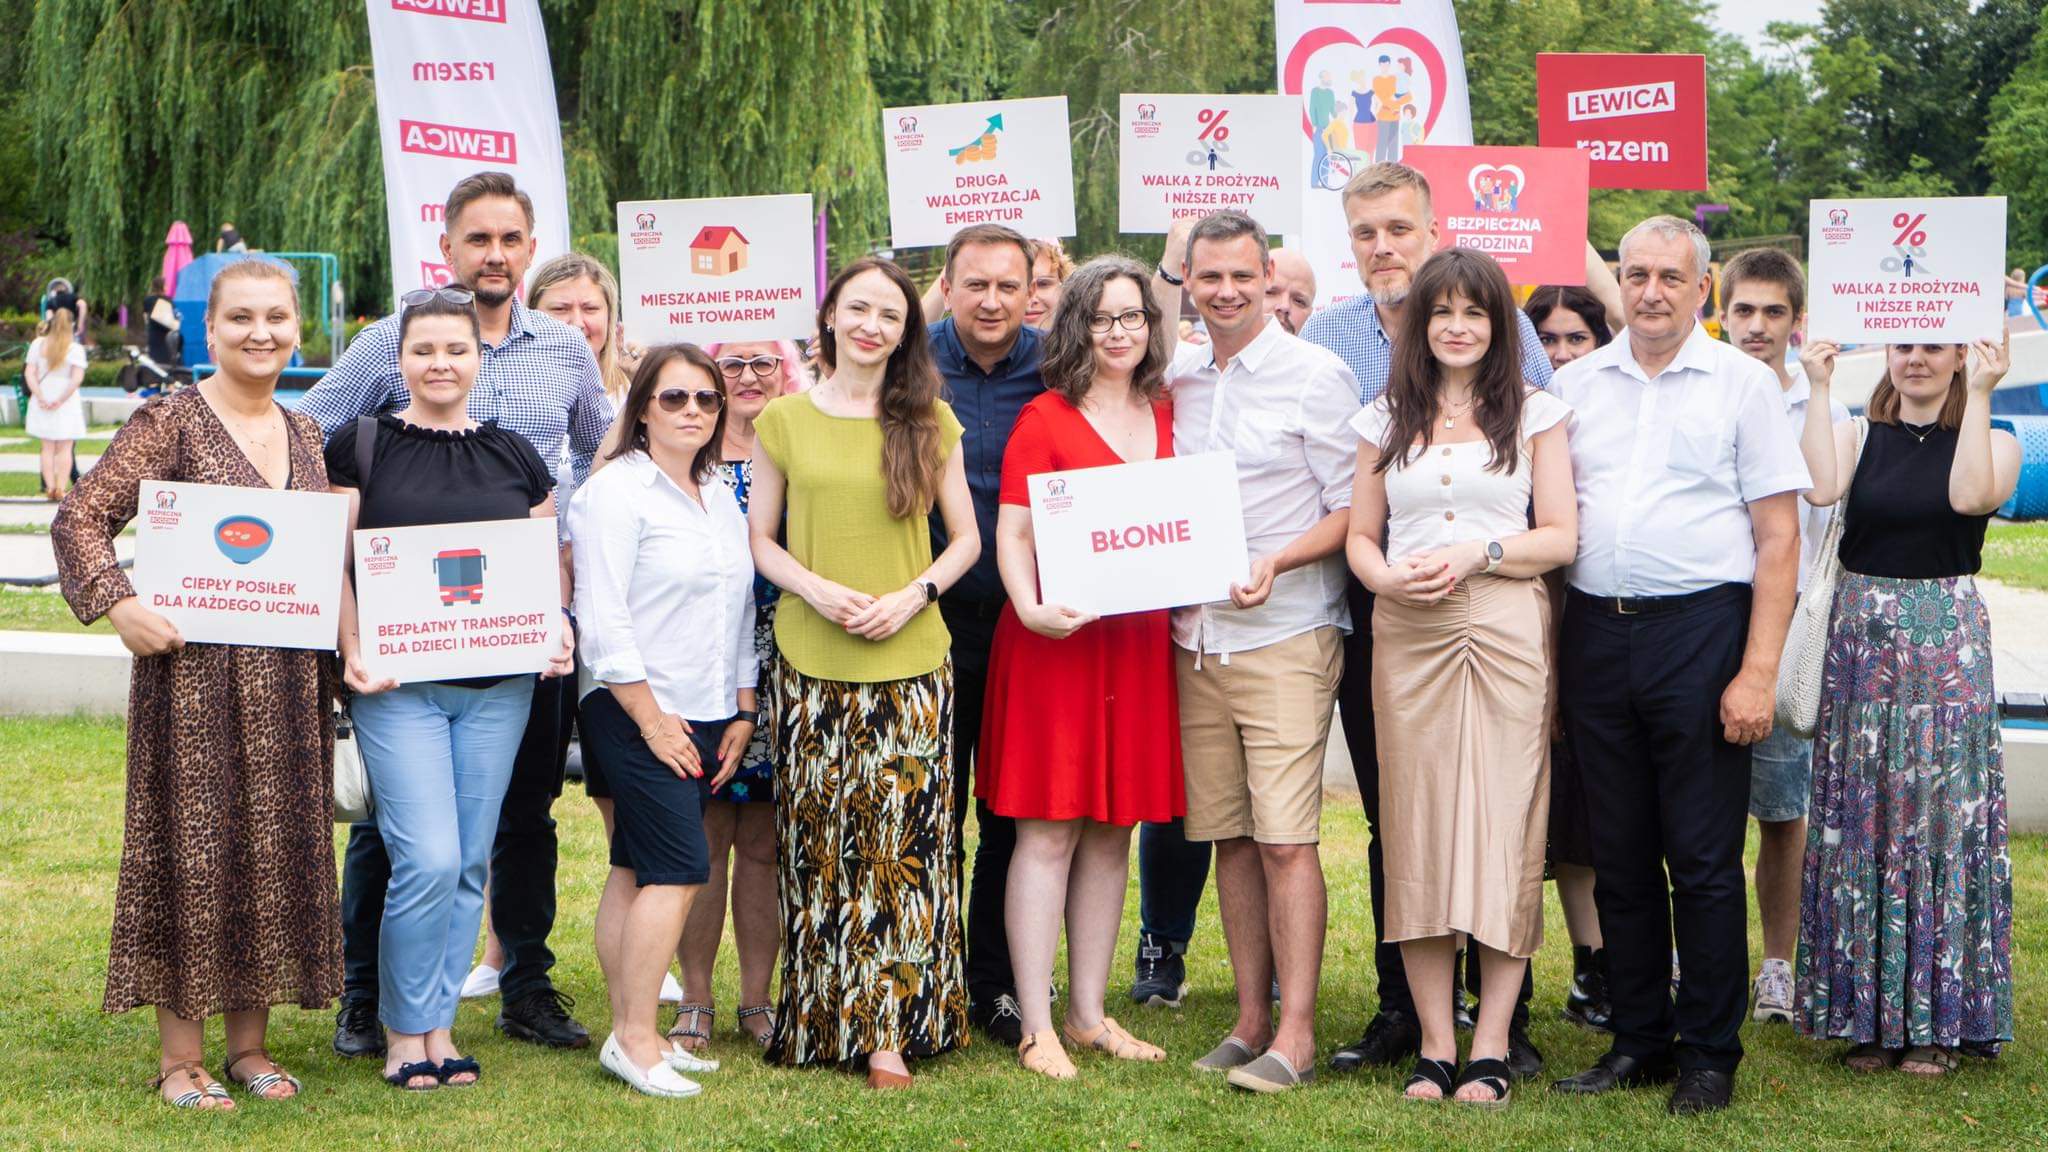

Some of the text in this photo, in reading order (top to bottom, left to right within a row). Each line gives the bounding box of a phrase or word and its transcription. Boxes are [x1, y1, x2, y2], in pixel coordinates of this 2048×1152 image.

[1574, 87, 1670, 115] LEWICA
[955, 174, 1008, 188] DRUGA
[1142, 173, 1279, 190] WALKA Z DROŻYZNĄ
[926, 189, 1041, 208] WALORYZACJA
[1165, 190, 1255, 204] I NIŻSZE RATY
[945, 207, 1023, 224] EMERYTUR
[1172, 206, 1248, 219] KREDY
[1447, 216, 1542, 232] BEZPIECZNA
[1459, 236, 1529, 250] RODZINA
[1832, 279, 1980, 296] WALKA Z DROŻYZNĄ
[641, 287, 802, 307] MIESZKANIE PRAWEM
[1857, 298, 1953, 312] I NIŻSZE RATY
[669, 307, 776, 324] NIE TOWAREM
[1864, 314, 1946, 329] KREDYTÓW
[1091, 519, 1191, 553] BŁONIE
[182, 576, 296, 595] CIEPŁY POSIŁEK
[153, 594, 320, 616] DLA KAŻDEGO UCZNIA
[378, 613, 545, 637] BEZPŁATNY TRANSPORT
[379, 629, 547, 656] DLA DZIECI I MŁODZIEŻY
